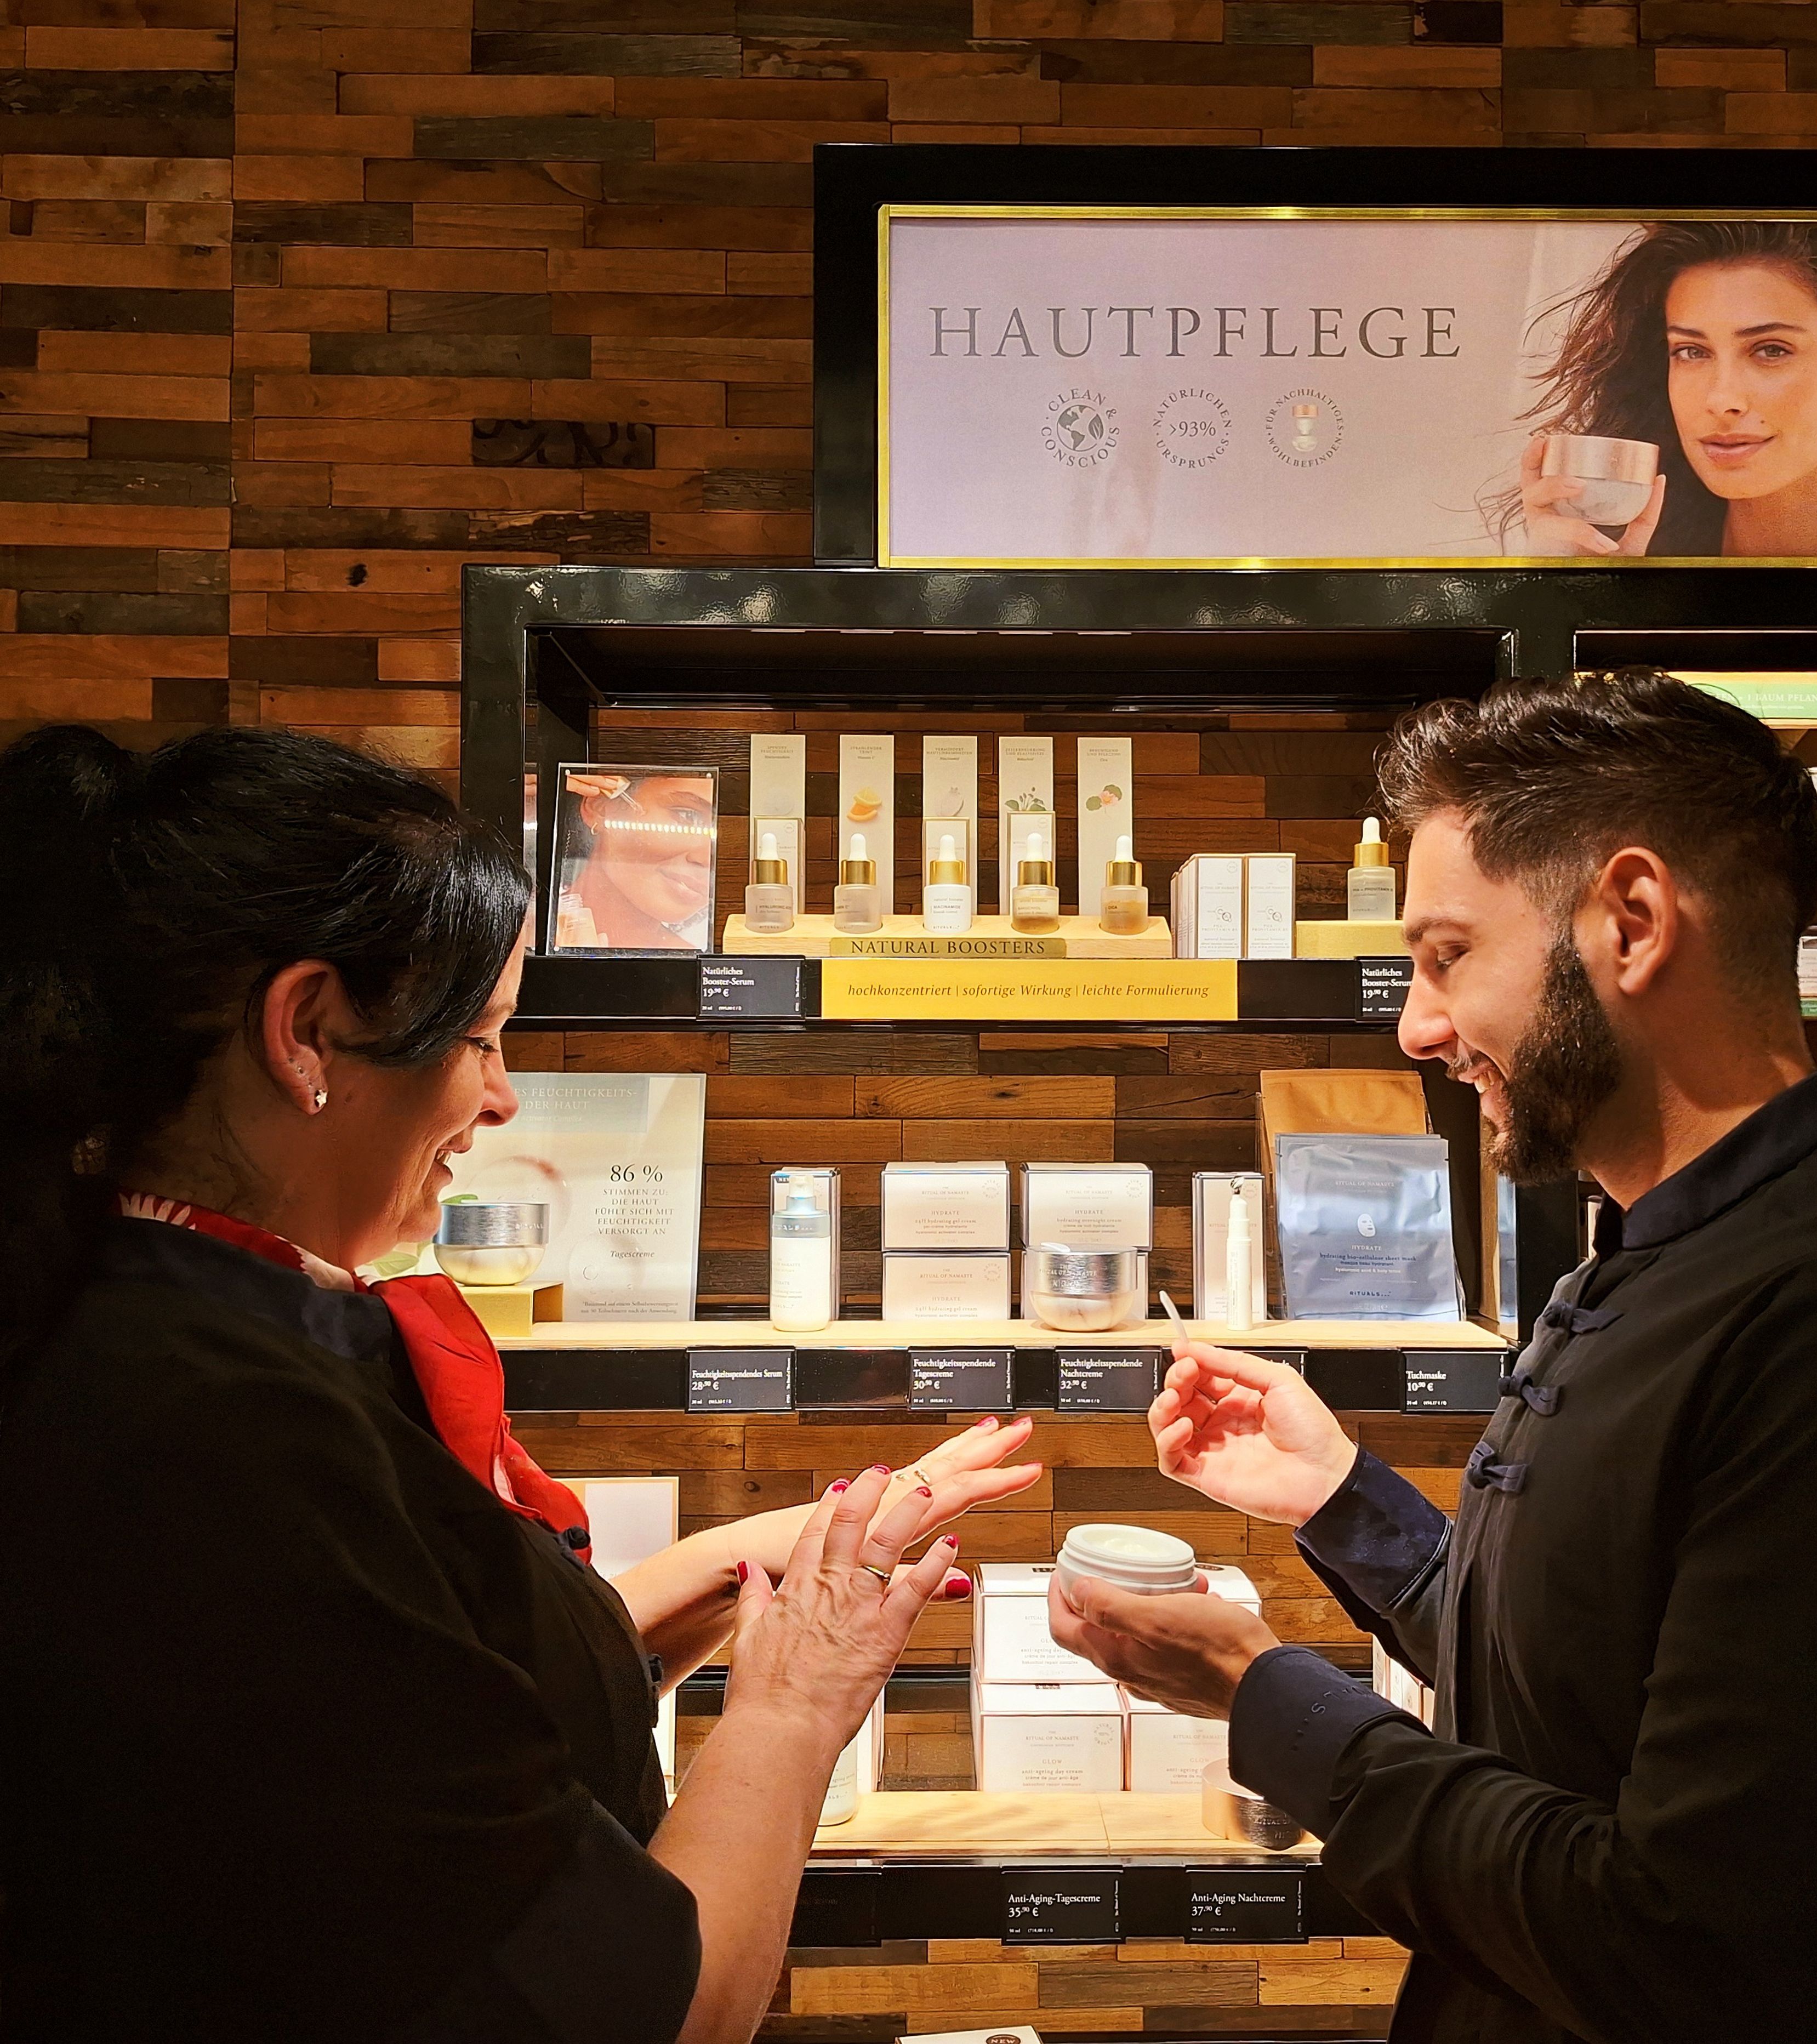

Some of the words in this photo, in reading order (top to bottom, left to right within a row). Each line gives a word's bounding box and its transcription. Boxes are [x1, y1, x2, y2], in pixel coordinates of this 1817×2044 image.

[929, 306, 1461, 358] HAUTPFLEGE
[1048, 389, 1107, 412] CLEAN
[1153, 388, 1232, 428] NATÜRLICHEN
[1266, 409, 1277, 429] FÜR
[1275, 388, 1344, 430] NACHHALTIGES
[1169, 421, 1216, 437] >93%
[1041, 426, 1120, 468] CONSCIOUS
[1267, 436, 1343, 468] WOHLBEFINDEN
[1155, 439, 1229, 469] URSPRUNGS
[851, 941, 939, 954] NATURAL
[947, 941, 1045, 954] BOOSTERS
[703, 967, 743, 975] Natürliches
[1362, 968, 1403, 976] Natürliches
[703, 977, 754, 986] Booster-Serum
[723, 989, 730, 997] €
[847, 984, 951, 996] hochkonzentriert
[962, 984, 1016, 998] sofortige
[1020, 984, 1072, 998] Wirkung
[1083, 983, 1123, 996] leichte
[1126, 984, 1209, 998] Formulierung
[1382, 990, 1389, 999] €
[532, 1089, 637, 1097] FEUCHTIGKEITS-
[526, 1101, 549, 1109] DER
[555, 1101, 590, 1109] HAUT
[611, 1164, 635, 1182] 86
[643, 1165, 663, 1183] %
[1320, 1252, 1346, 1260] hydrating
[913, 1358, 996, 1369] Feuchtigkeitsspendende
[1060, 1358, 1143, 1369] Feuchtigkeitsspendende
[764, 1369, 783, 1377] Serum
[913, 1369, 954, 1380] Tagescreme
[1061, 1369, 1103, 1378] Nachtcreme
[1406, 1370, 1446, 1380] Tuchmaske
[713, 1381, 719, 1390] €
[934, 1381, 940, 1390] €
[1081, 1380, 1087, 1390] €
[1427, 1382, 1434, 1391] €
[1008, 1893, 1101, 1905] Anti-Aging-Tagescreme
[1191, 1893, 1236, 1905] Anti-Aging
[1238, 1893, 1285, 1902] Nachtcreme
[1033, 1907, 1039, 1917] €
[1215, 1906, 1221, 1916] €
